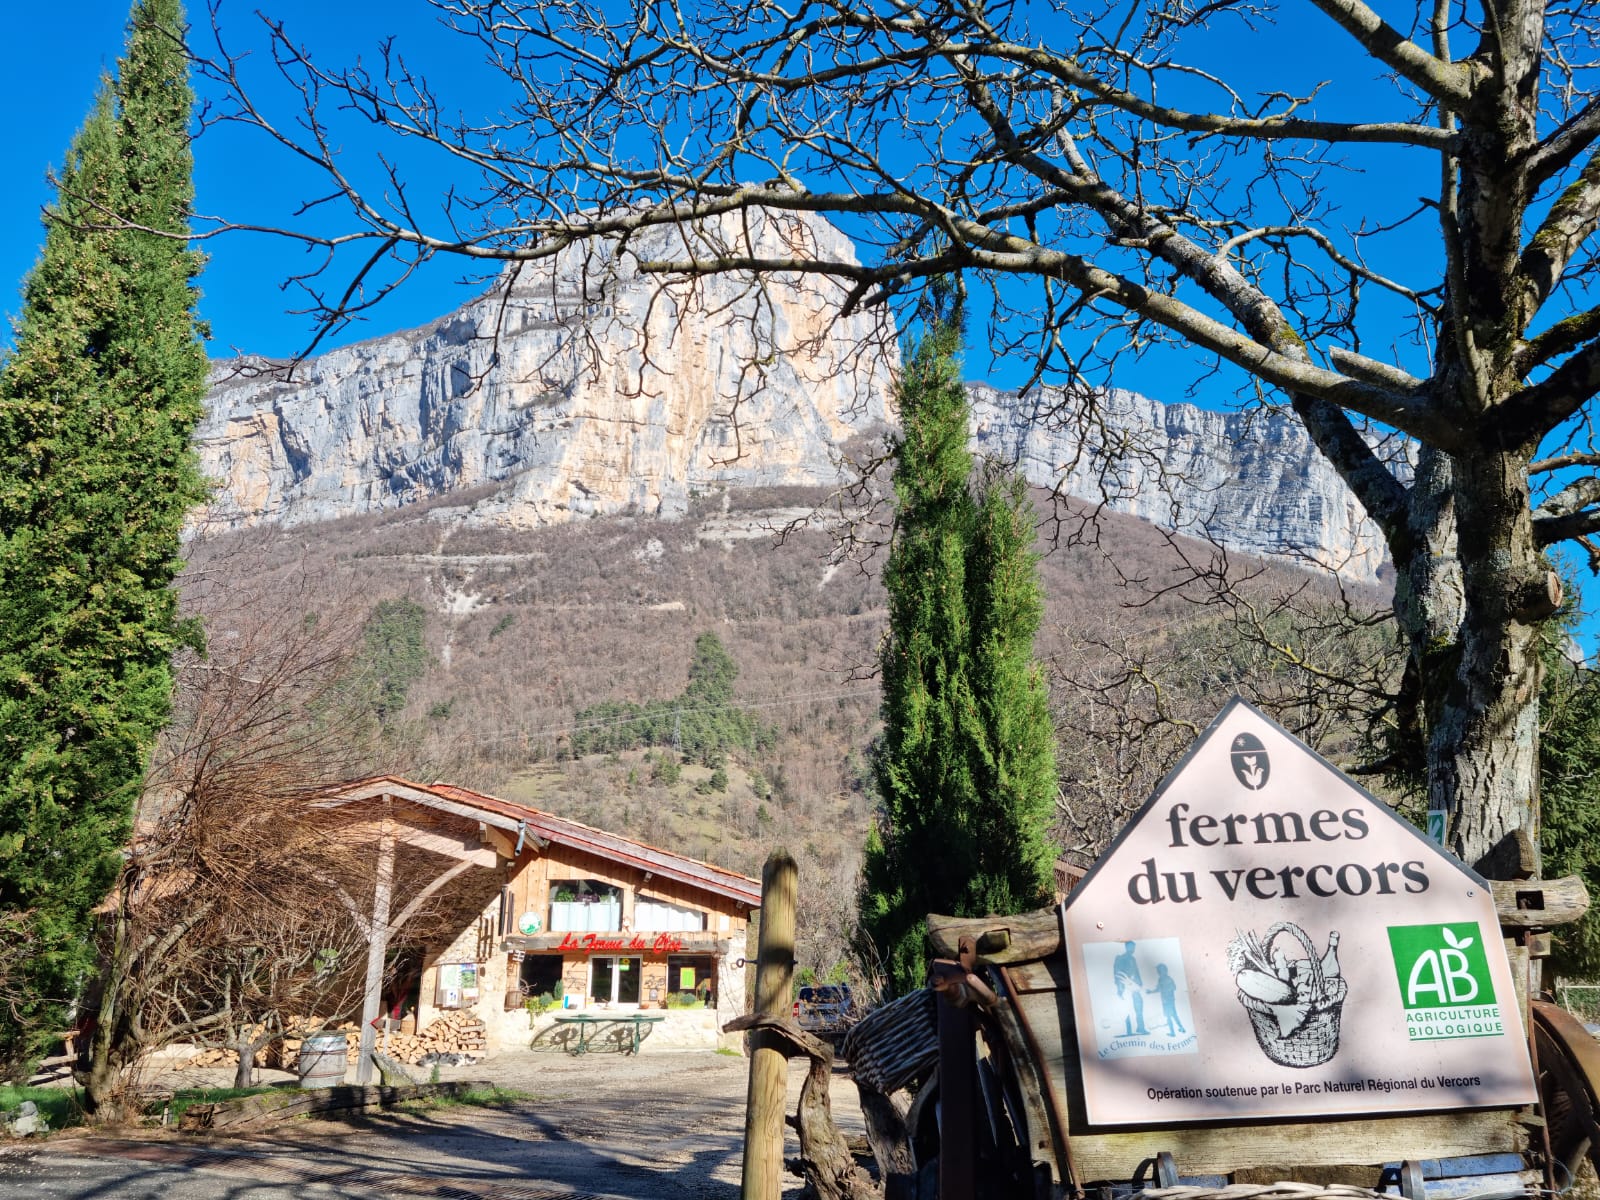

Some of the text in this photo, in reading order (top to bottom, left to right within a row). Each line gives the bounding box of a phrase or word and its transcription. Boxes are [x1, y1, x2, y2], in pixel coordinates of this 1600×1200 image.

[1165, 802, 1369, 848] fermes
[1127, 857, 1430, 905] du vercors
[582, 933, 624, 955] Ferme
[629, 933, 646, 950] du
[1407, 948, 1479, 1006] AB
[1406, 1008, 1500, 1023] AGRICULTURE
[1408, 1022, 1503, 1037] BIOLOGIQUE
[1110, 1039, 1147, 1051] Chemin
[1149, 1040, 1165, 1051] des
[1147, 1075, 1481, 1101] Opération soutenue par le Parc Naturel Régional du Vercors
